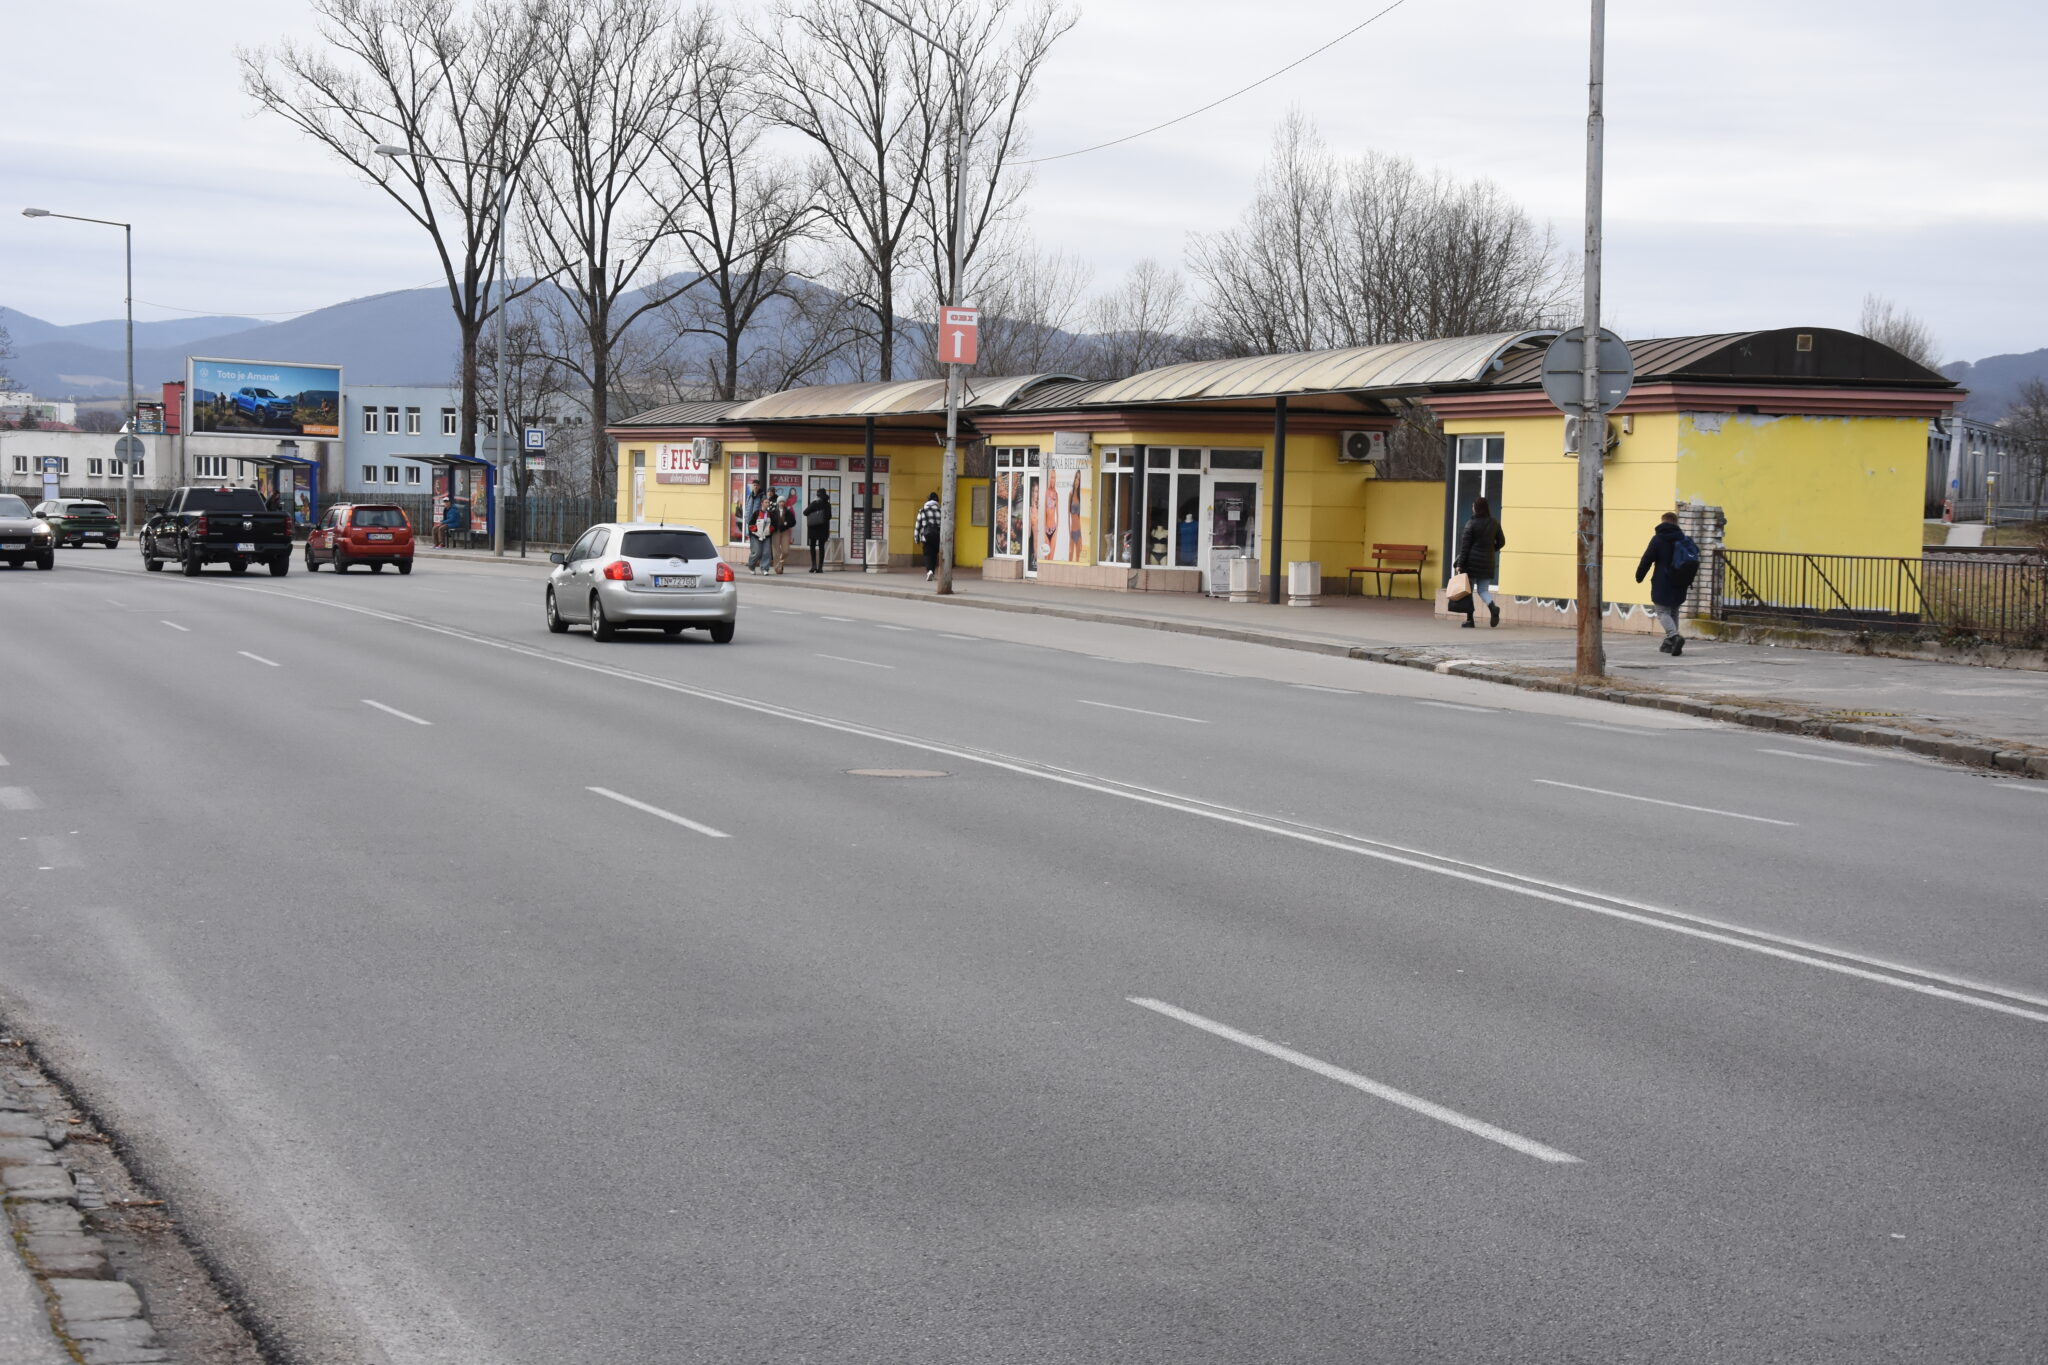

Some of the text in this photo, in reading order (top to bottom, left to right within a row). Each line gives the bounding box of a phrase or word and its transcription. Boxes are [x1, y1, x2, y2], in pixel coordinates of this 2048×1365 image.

[216, 370, 280, 382] Toto je Amarok
